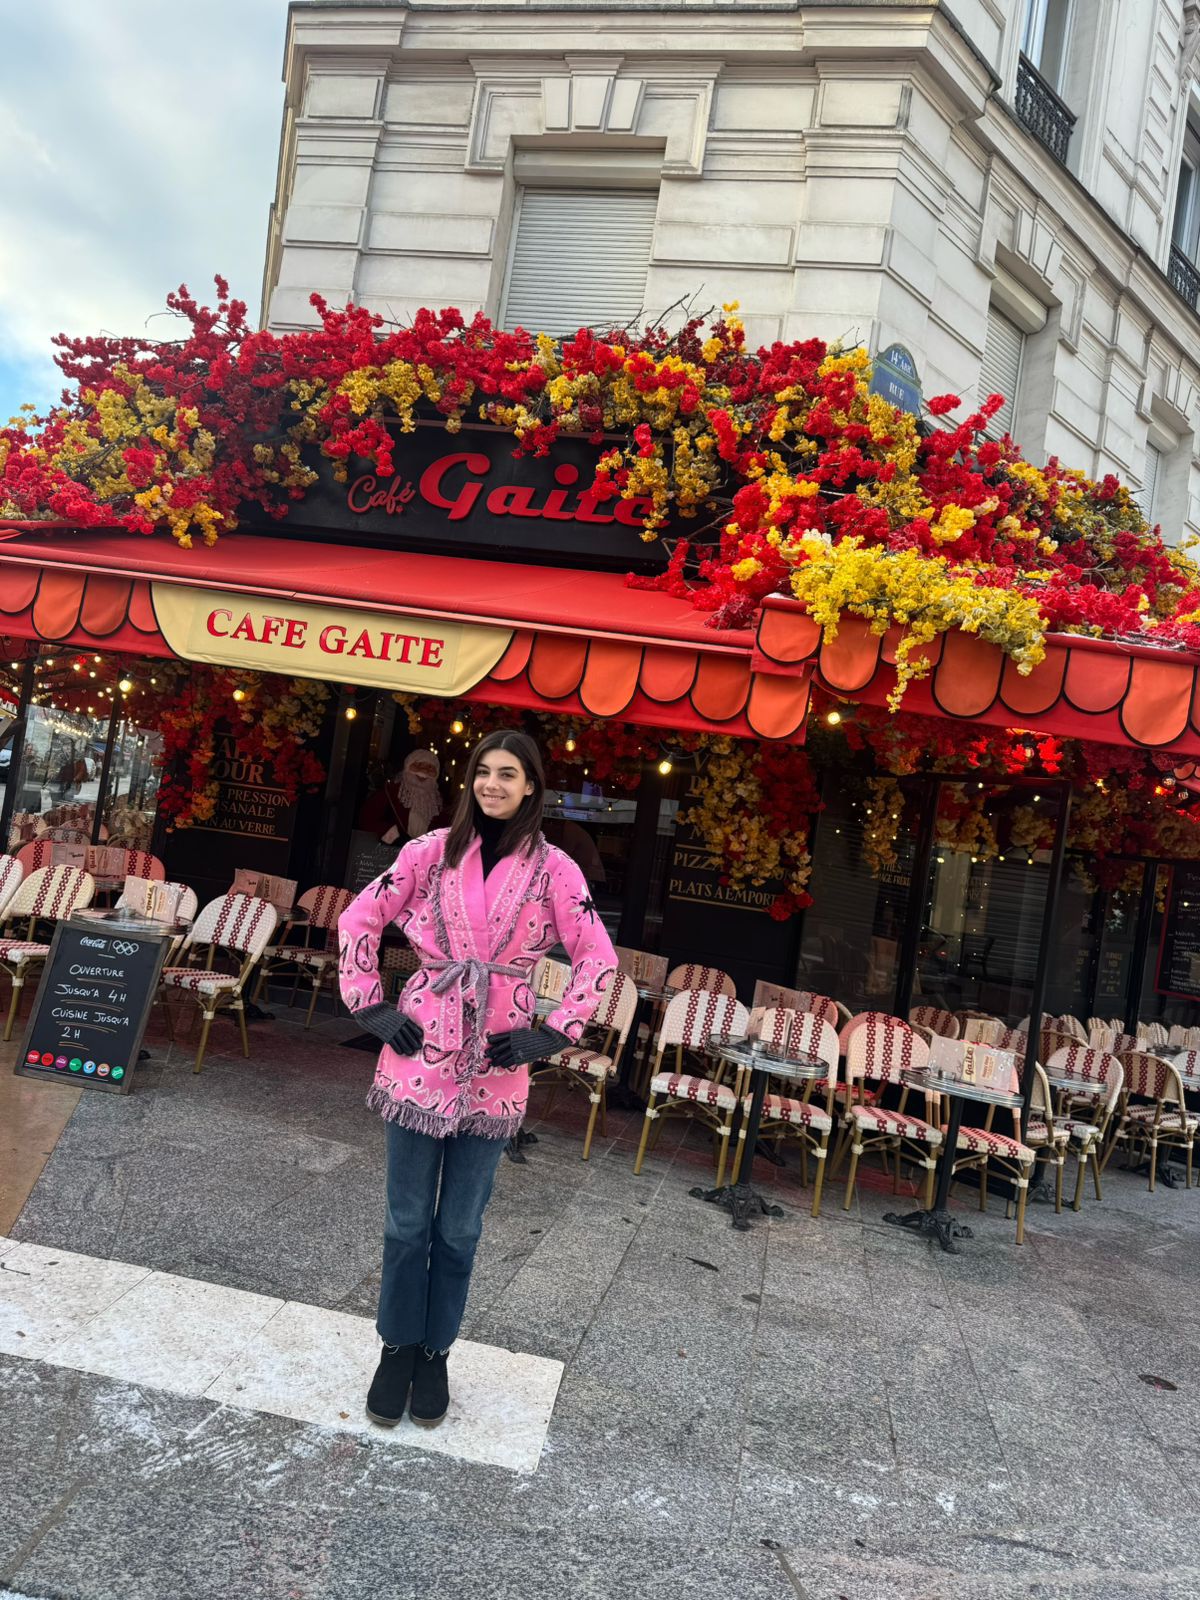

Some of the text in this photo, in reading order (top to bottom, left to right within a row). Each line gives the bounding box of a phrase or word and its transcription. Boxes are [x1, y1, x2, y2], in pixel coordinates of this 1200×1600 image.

[889, 382, 904, 401] RUE
[347, 474, 416, 515] Café
[206, 608, 445, 668] CAFE GAITE
[213, 760, 264, 785] OUR
[227, 788, 291, 807] PRESSION
[220, 817, 237, 829] AU
[239, 820, 276, 835] VERRE
[668, 879, 713, 898] PLATS
[725, 888, 777, 907] EMPORT
[69, 963, 124, 978] OUVERTURE
